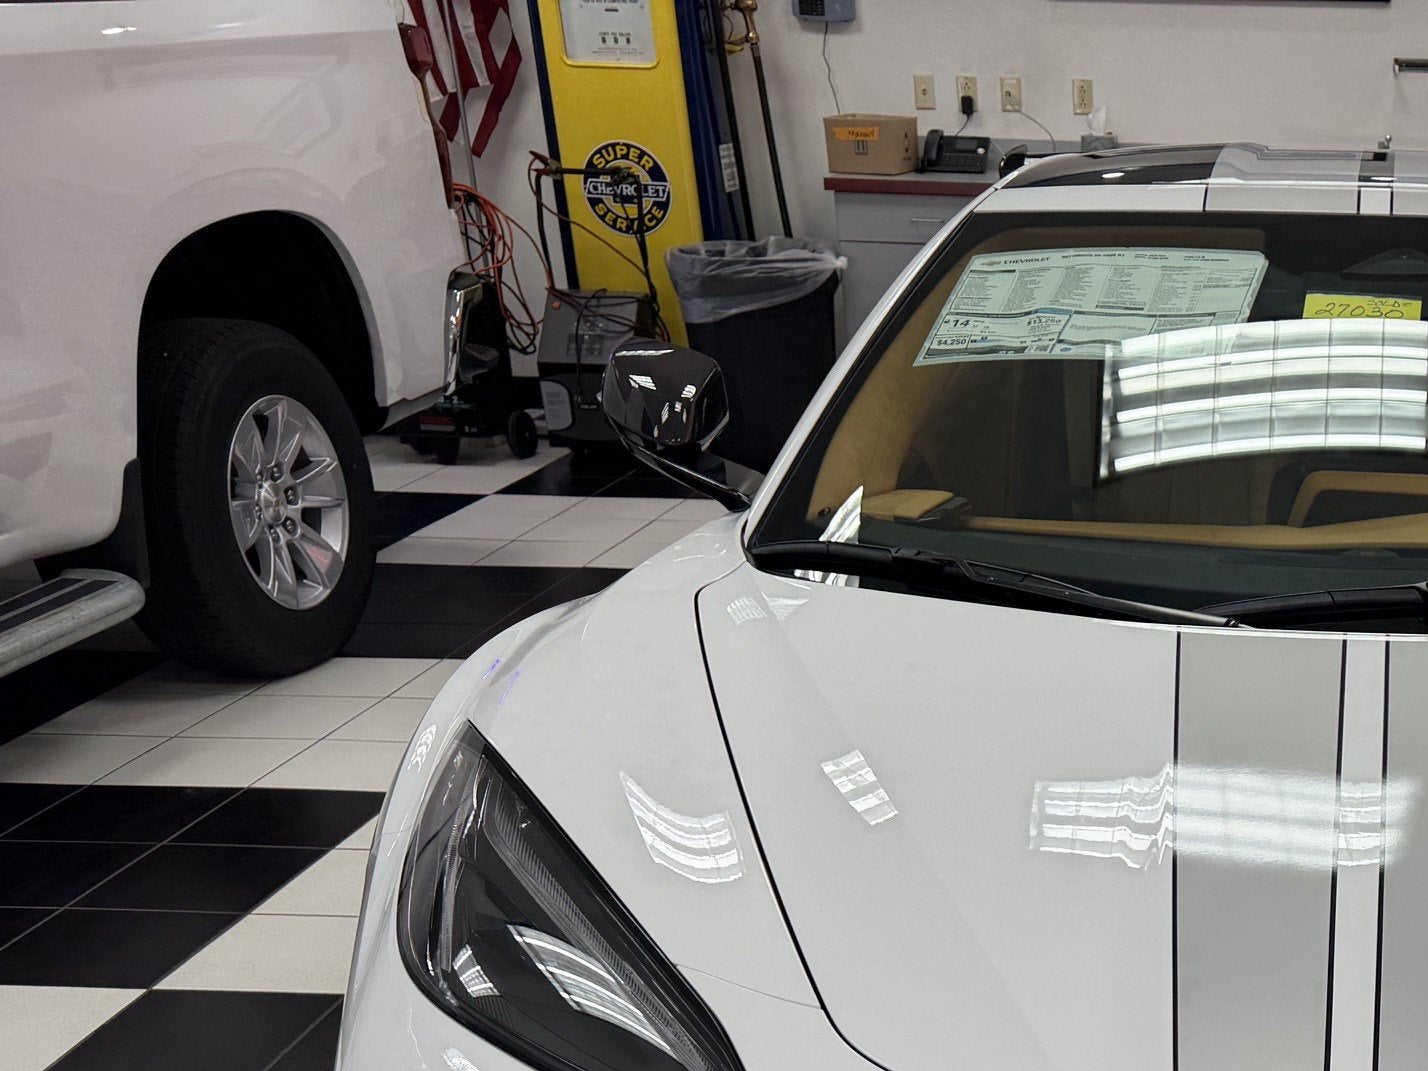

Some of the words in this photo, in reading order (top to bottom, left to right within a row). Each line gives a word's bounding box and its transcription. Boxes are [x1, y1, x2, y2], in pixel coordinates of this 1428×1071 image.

[592, 144, 654, 170] SUPER
[594, 203, 664, 231] SERCE
[1314, 302, 1405, 319] 27030
[951, 319, 971, 328] 14
[936, 337, 967, 346] $4,250
